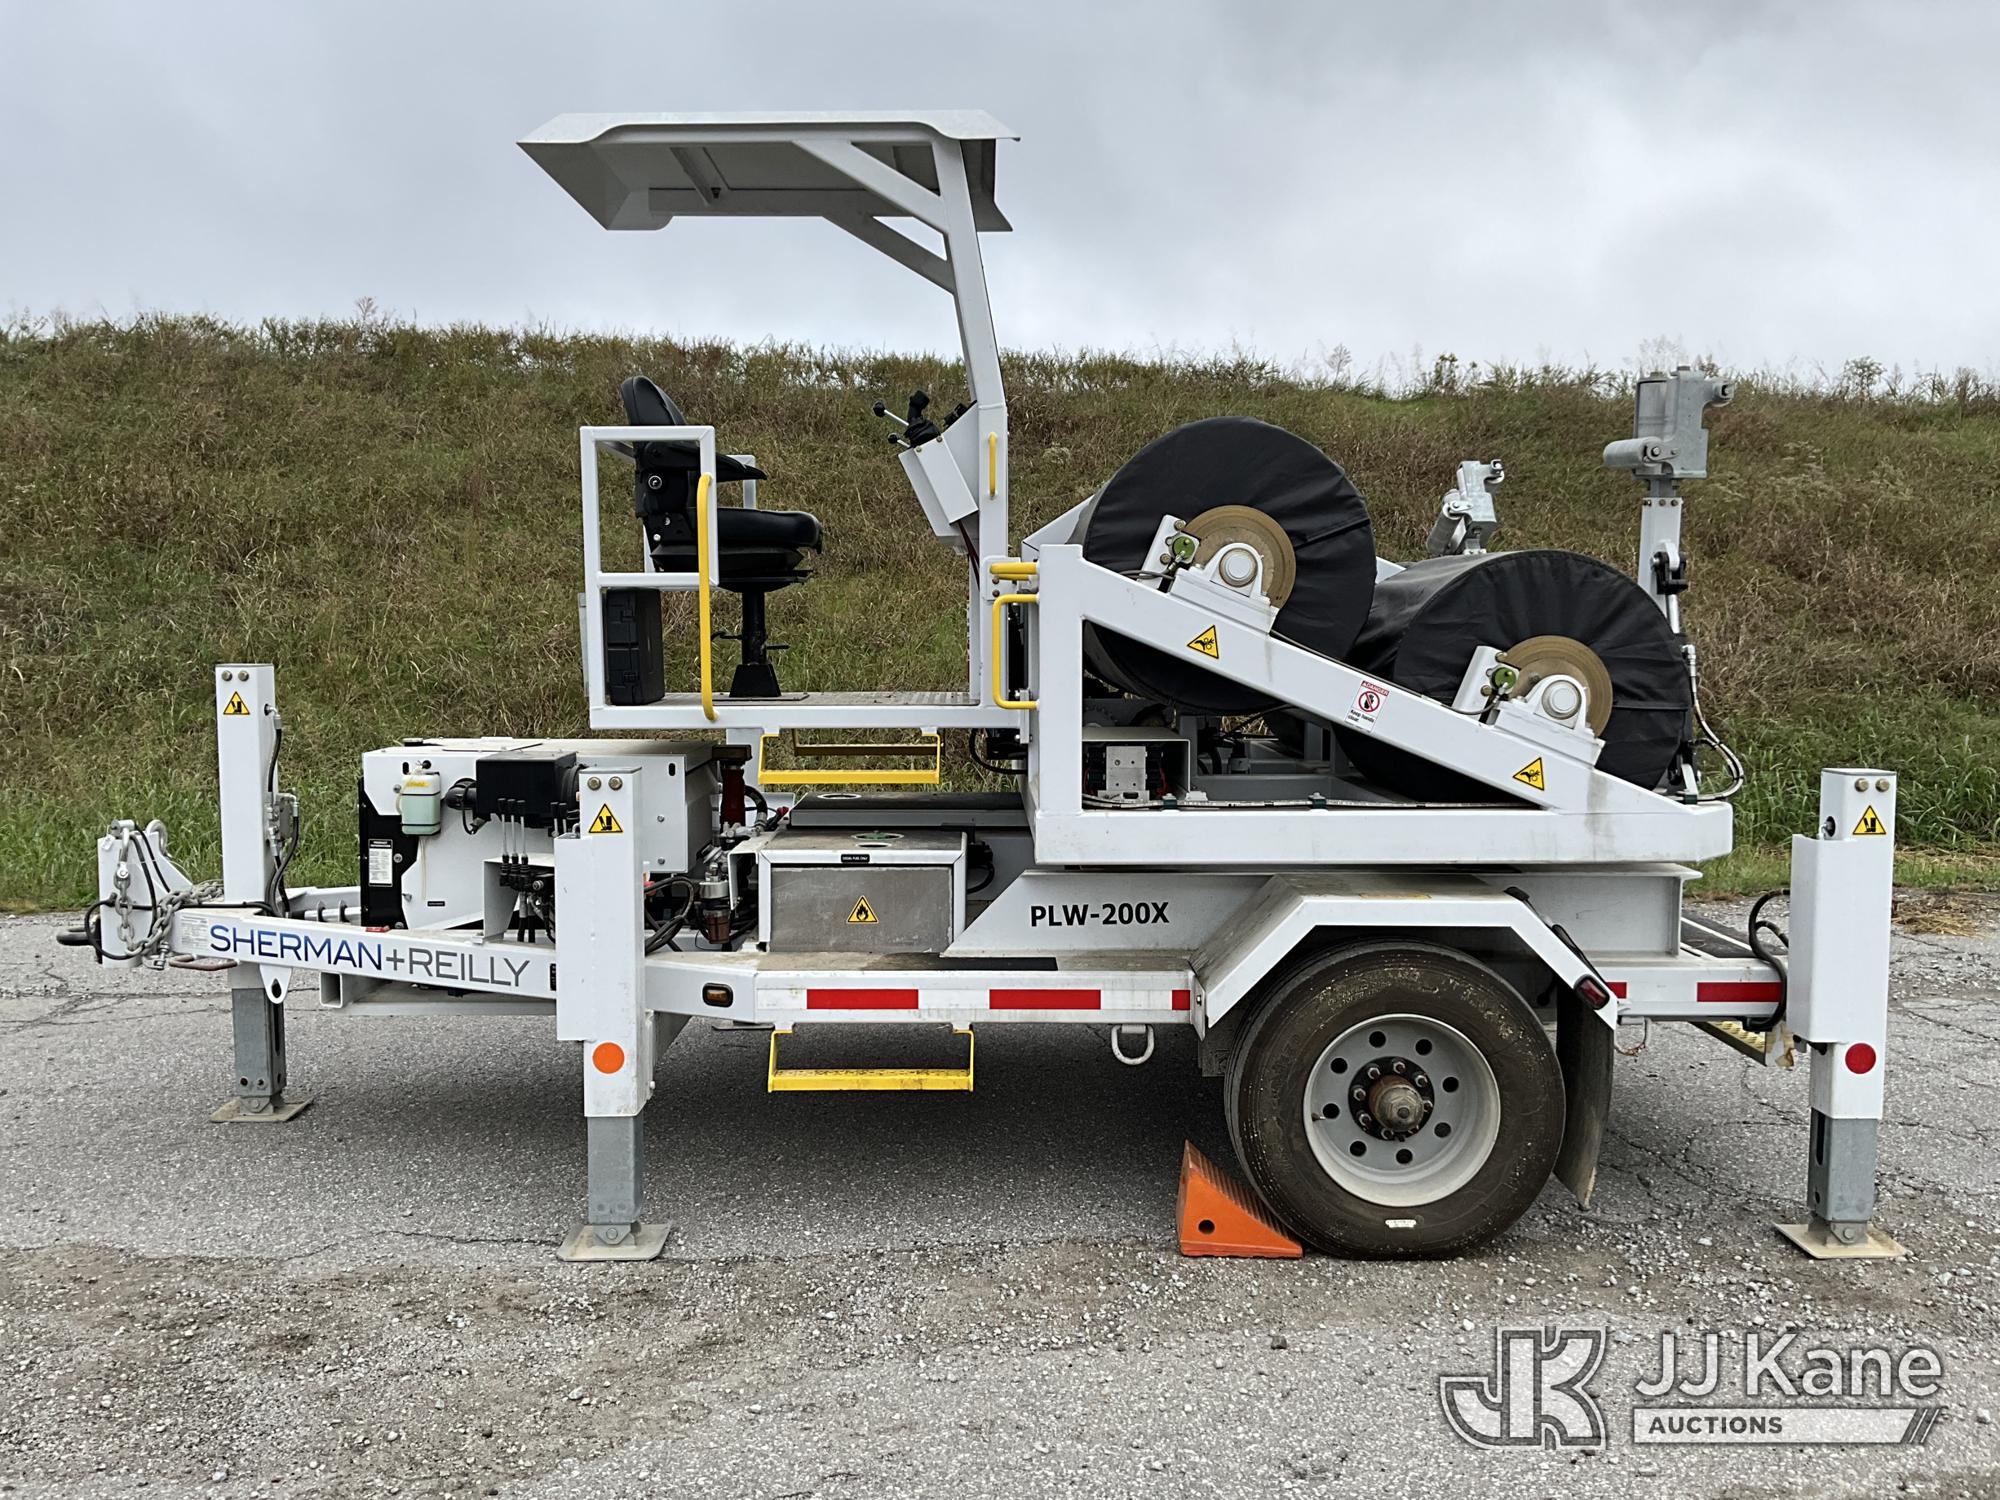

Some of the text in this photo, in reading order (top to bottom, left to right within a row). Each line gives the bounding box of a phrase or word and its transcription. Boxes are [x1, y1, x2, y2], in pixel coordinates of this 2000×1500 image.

[1365, 682, 1388, 696] DANGER
[1030, 902, 1170, 927] PLW-200X
[209, 924, 531, 988] SHERMAN+REILLY
